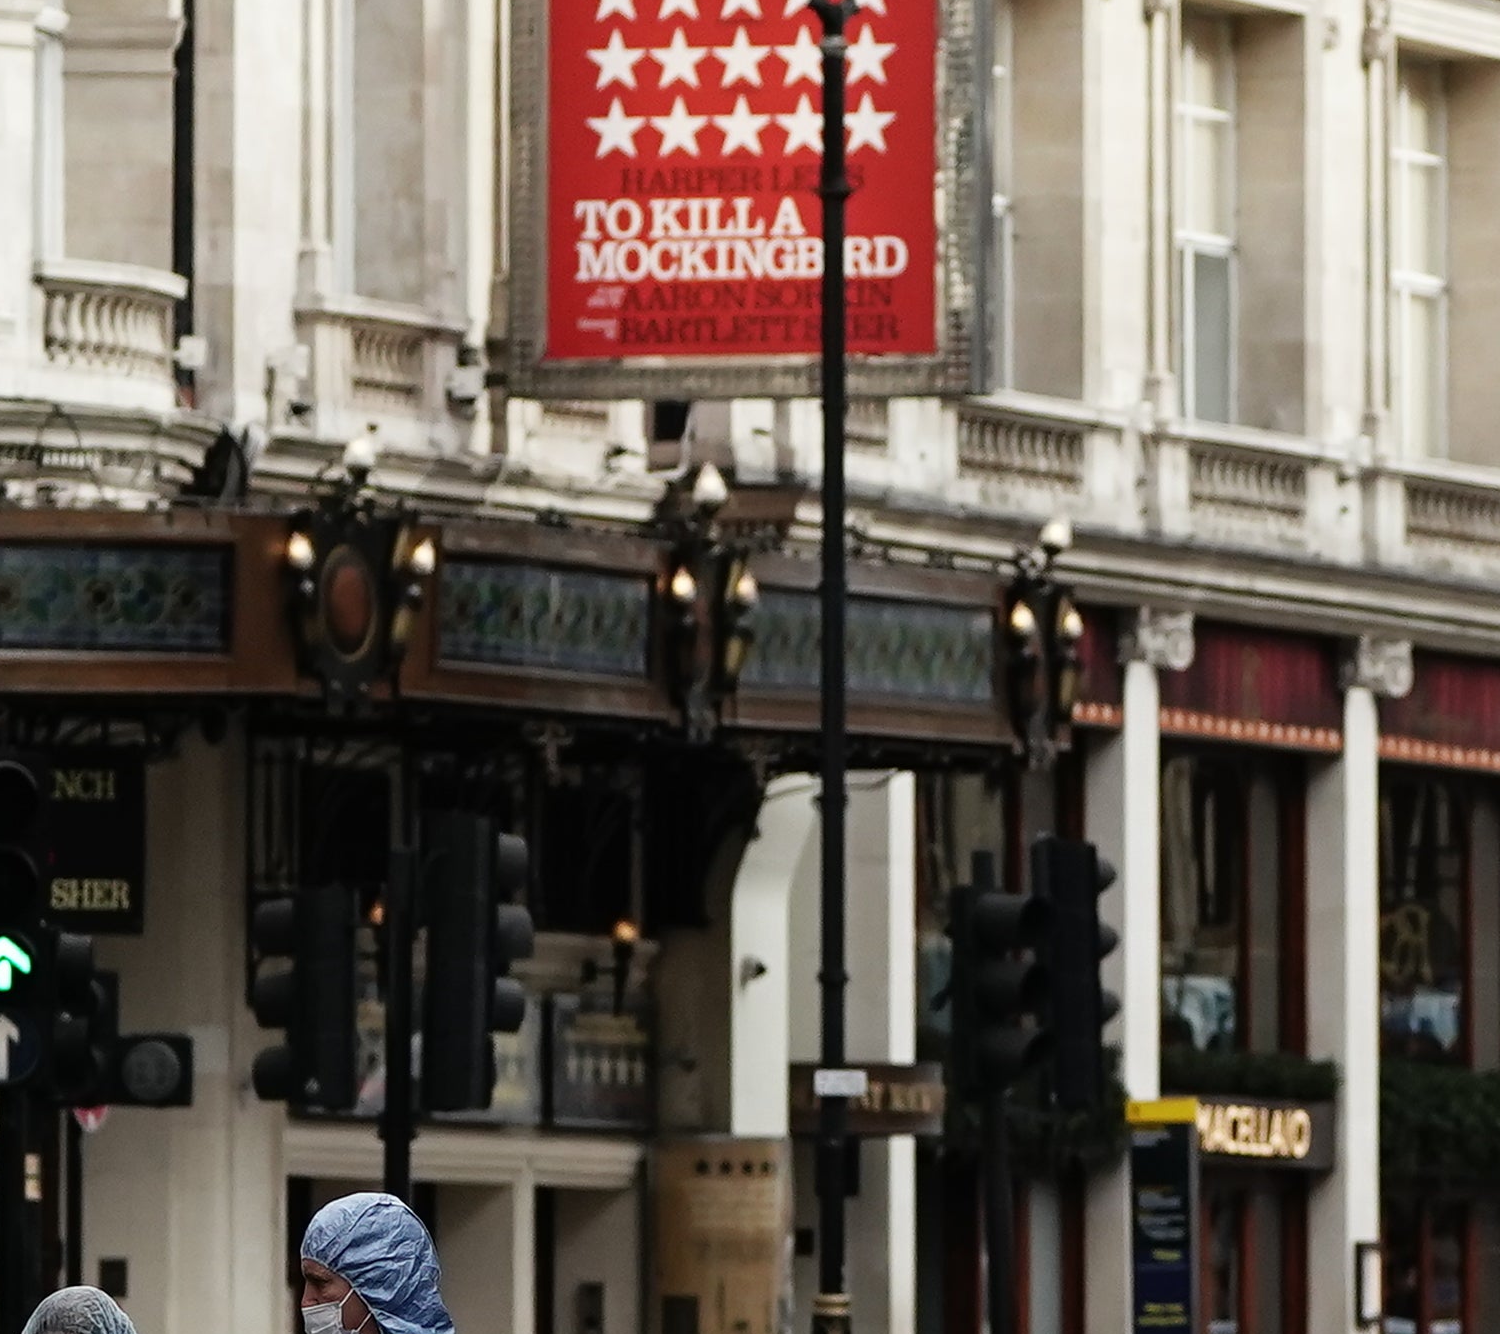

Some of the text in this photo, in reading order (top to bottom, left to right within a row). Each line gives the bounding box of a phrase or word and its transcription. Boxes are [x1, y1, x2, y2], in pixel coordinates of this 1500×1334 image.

[621, 166, 762, 194] HARPER
[573, 195, 809, 240] TO KILL A
[574, 234, 910, 283] MOCKINGBRD
[624, 283, 750, 312] AARON
[52, 769, 117, 799] NCH
